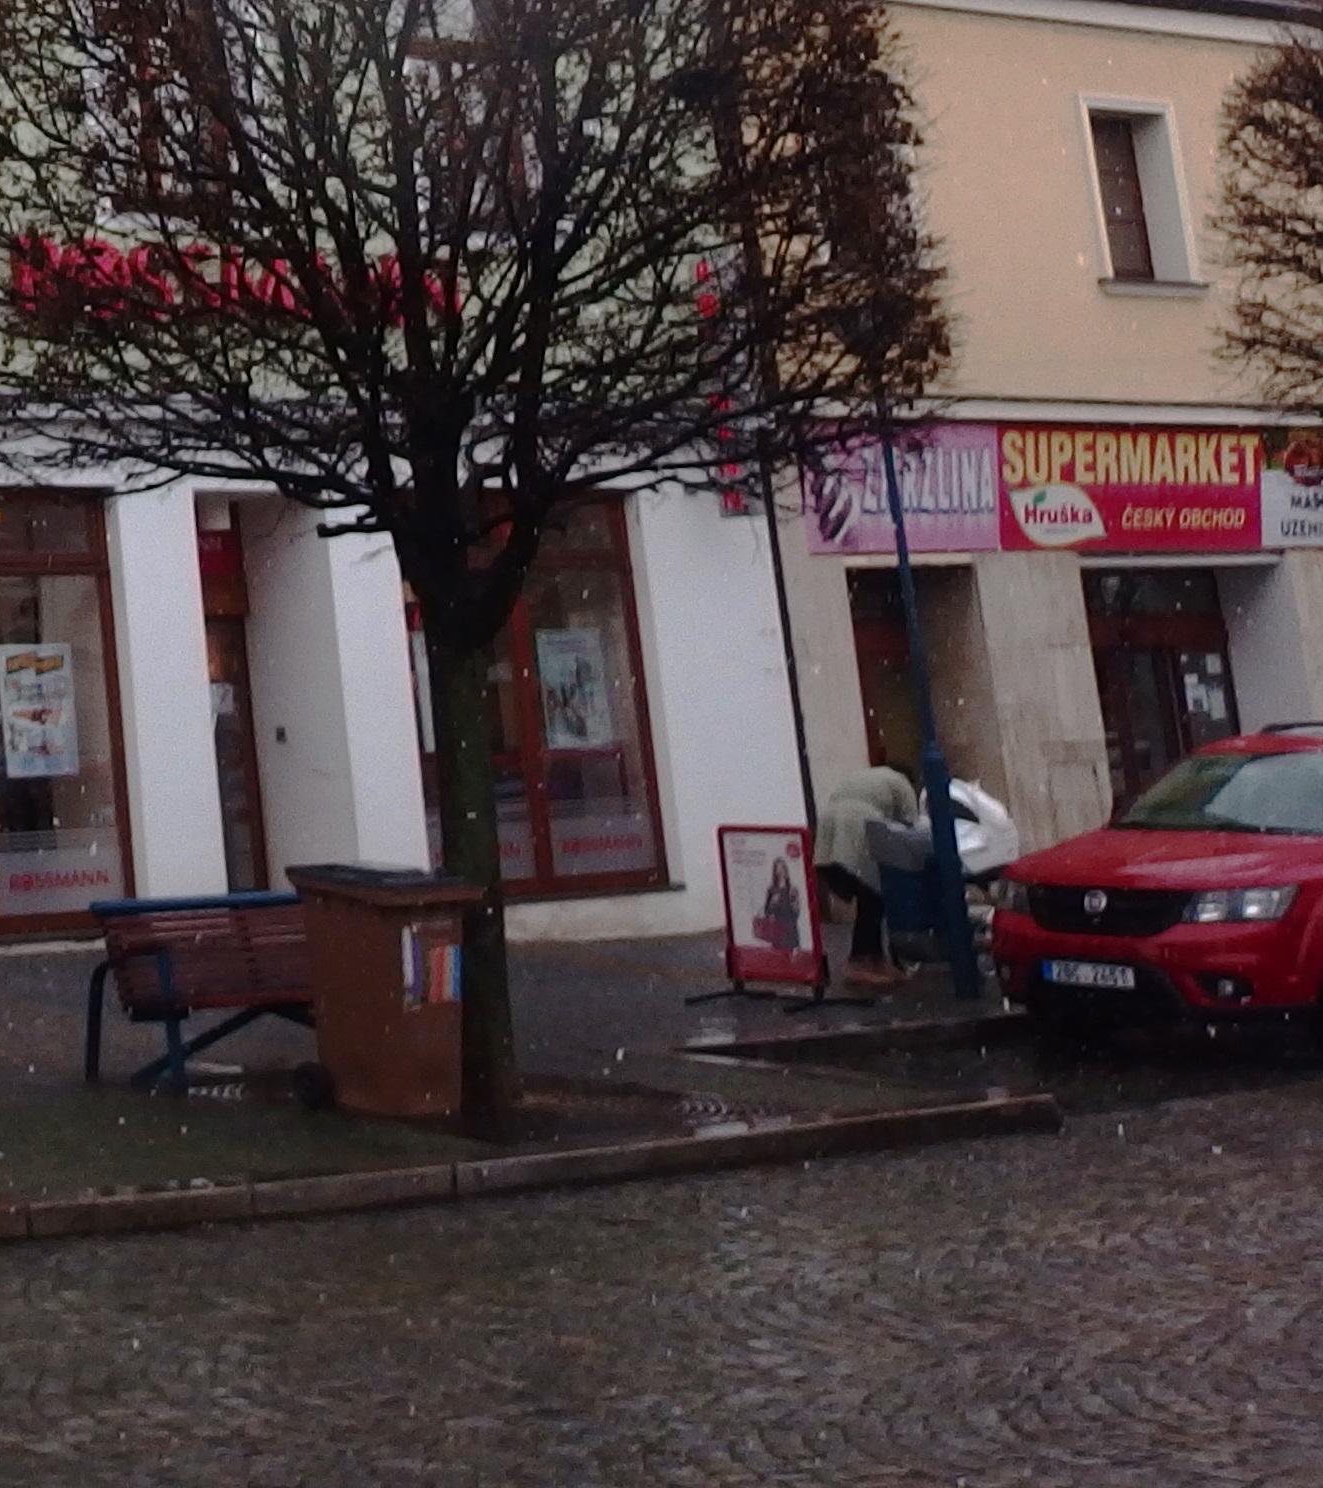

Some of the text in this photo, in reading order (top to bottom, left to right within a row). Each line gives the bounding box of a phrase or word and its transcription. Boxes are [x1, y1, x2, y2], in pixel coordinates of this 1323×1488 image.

[1001, 429, 1260, 486] SUPERMARKET
[1024, 503, 1093, 524] Hruška
[1121, 503, 1246, 530] ČESKÝ OBCHOD
[9, 869, 110, 893] ROSSMANN
